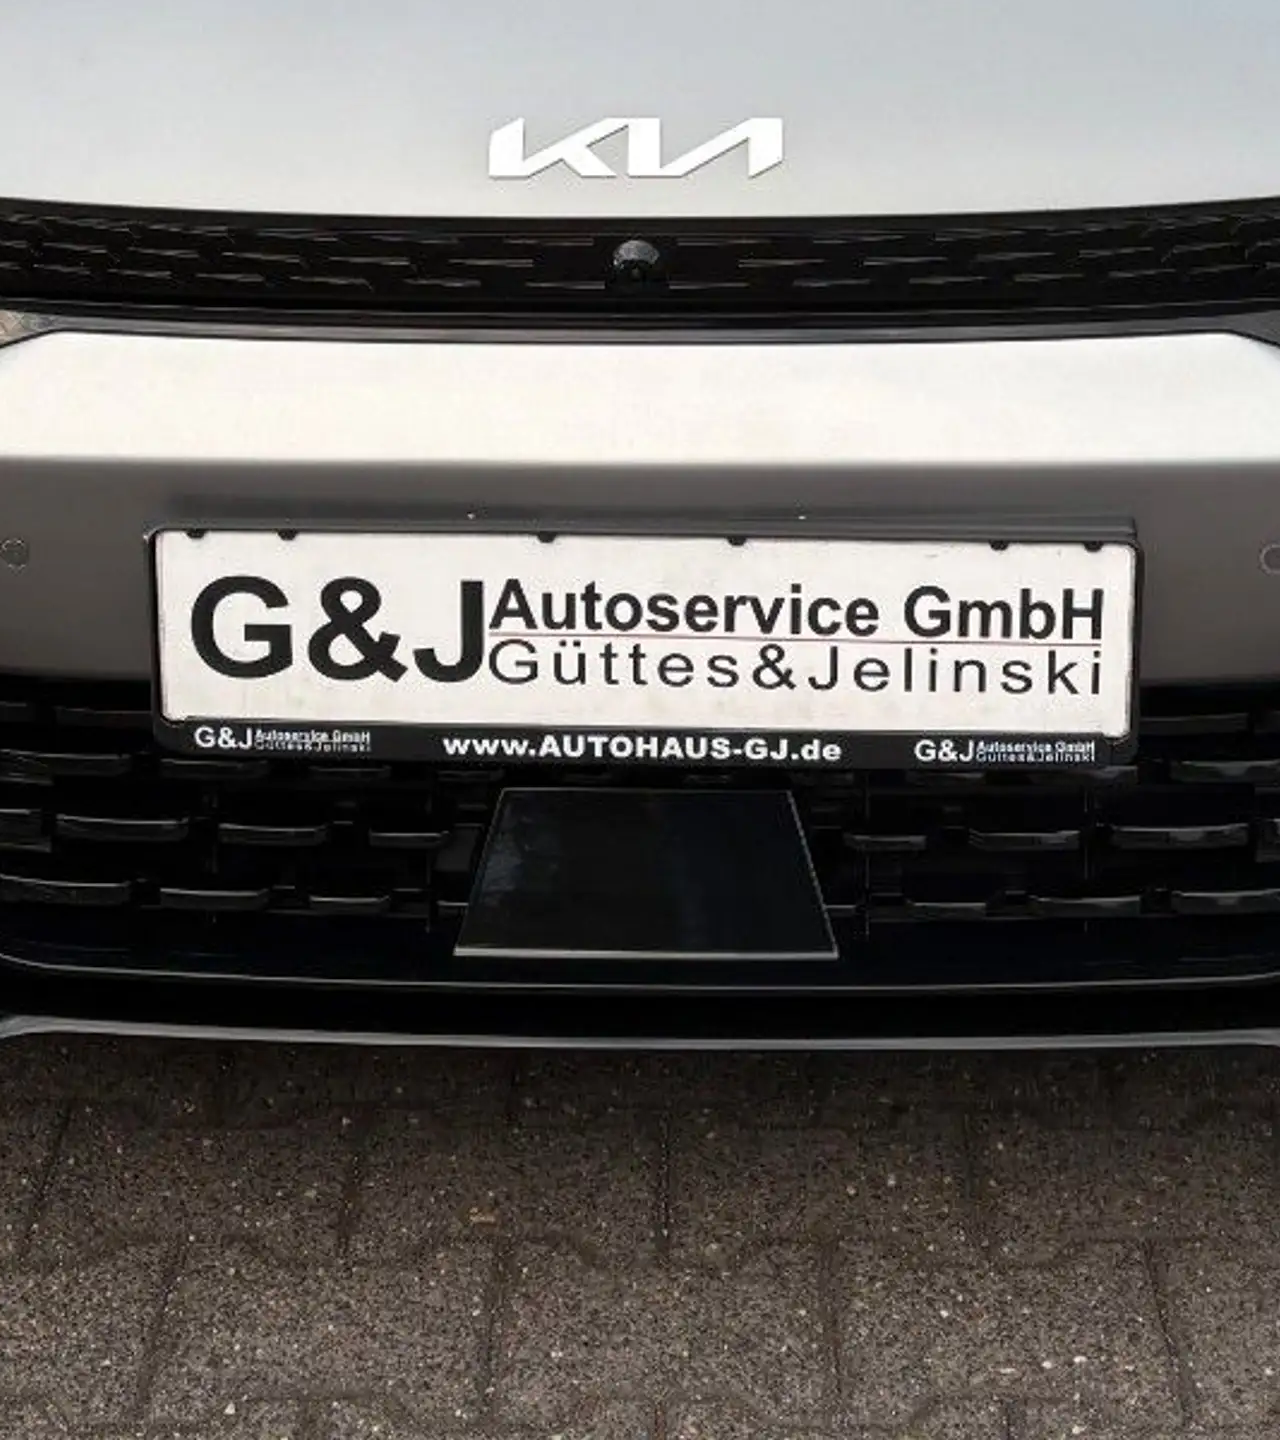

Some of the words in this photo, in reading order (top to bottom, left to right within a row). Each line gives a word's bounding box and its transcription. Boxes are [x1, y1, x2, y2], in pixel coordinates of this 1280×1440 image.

[488, 116, 784, 180] KIA
[190, 574, 485, 683] G&J
[488, 578, 880, 637] Autoservice
[903, 584, 1105, 641] GmbH
[488, 638, 1102, 696] Güttes&Jelinski
[193, 725, 253, 751] G&J
[442, 733, 842, 761] www.AUTOHAUS-GJ.de
[913, 738, 974, 763] G&J
